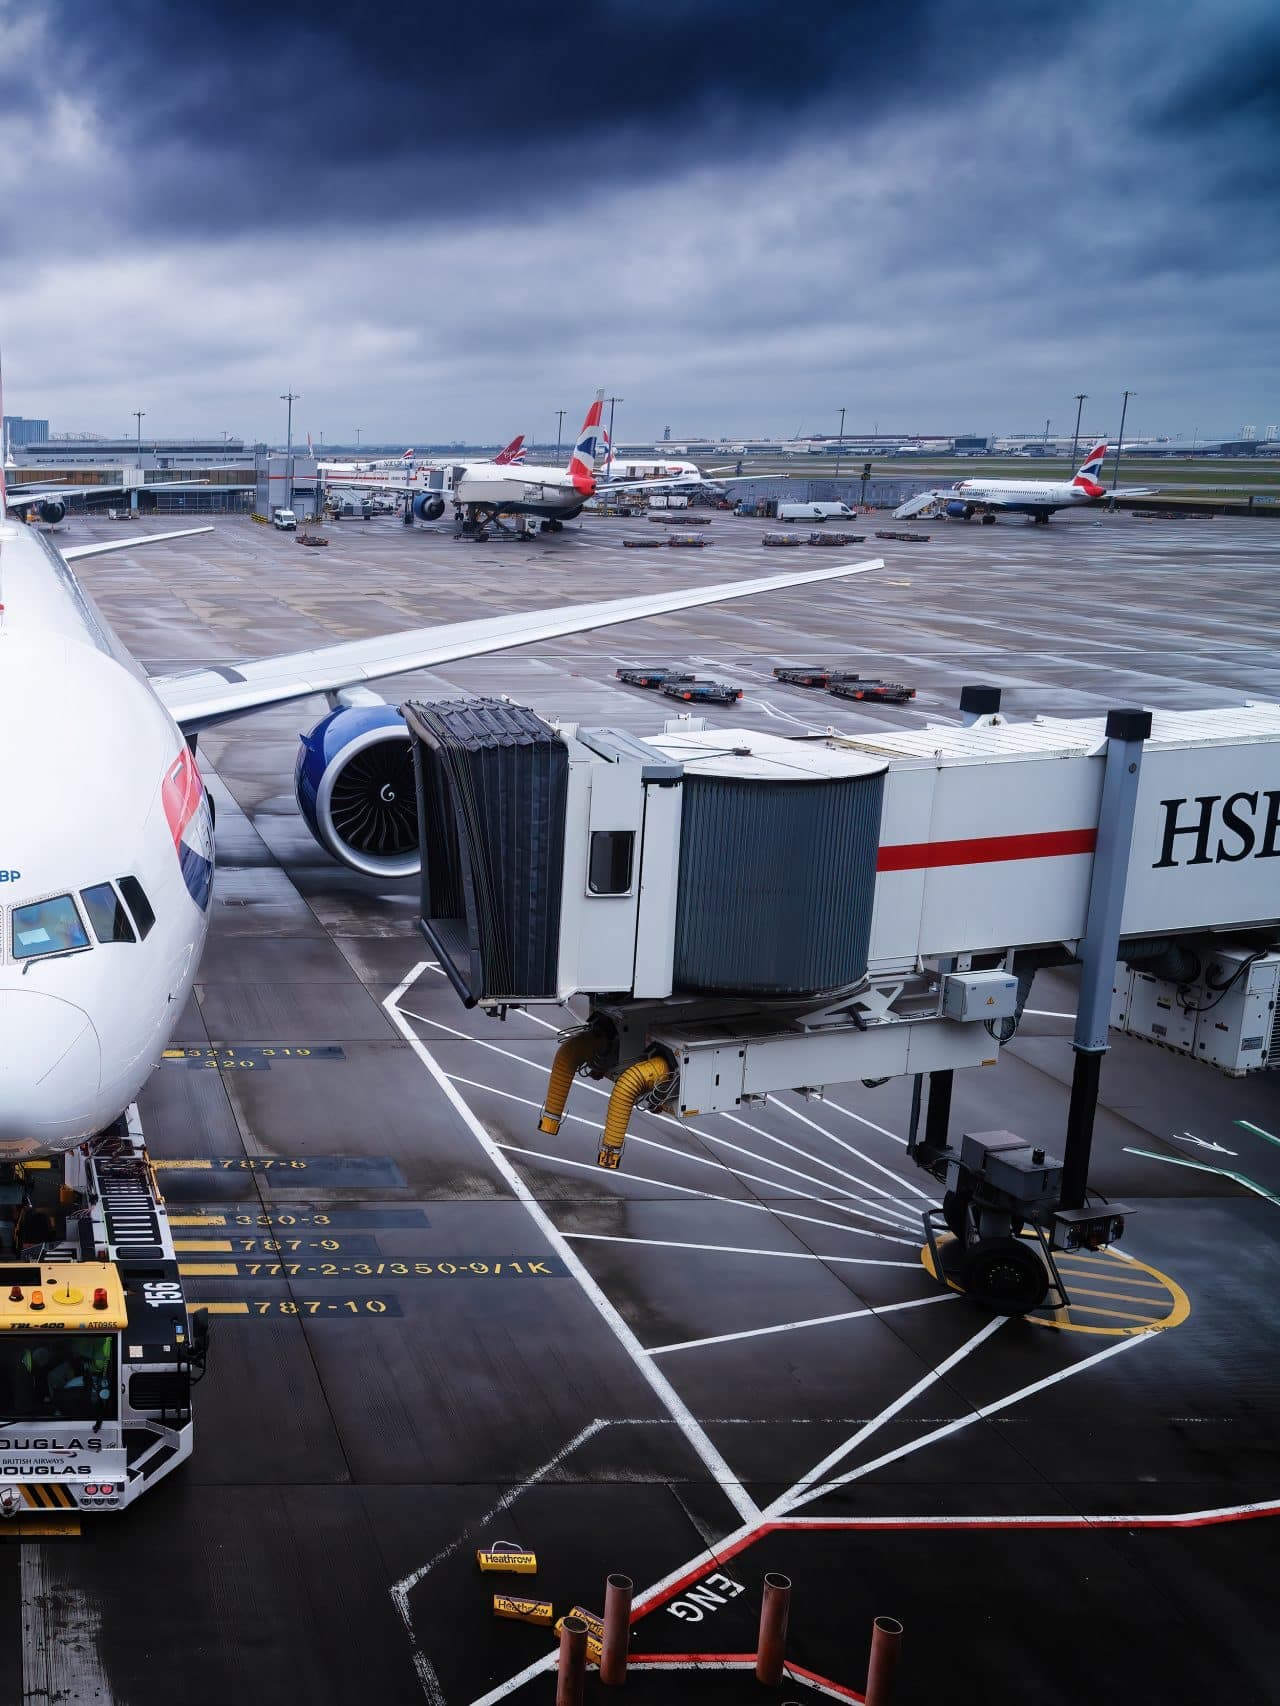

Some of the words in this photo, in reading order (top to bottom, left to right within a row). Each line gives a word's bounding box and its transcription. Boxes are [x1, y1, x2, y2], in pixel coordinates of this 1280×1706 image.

[220, 1160, 307, 1169] 787-8
[235, 1215, 332, 1226] 330-3
[239, 1240, 341, 1251] 787-9
[245, 1262, 552, 1275] 777-2-3/350-9/1K
[143, 1282, 183, 1308] 156
[254, 1302, 388, 1314] 787-10
[484, 1553, 533, 1565] Heathrow
[666, 1572, 746, 1622] ENG
